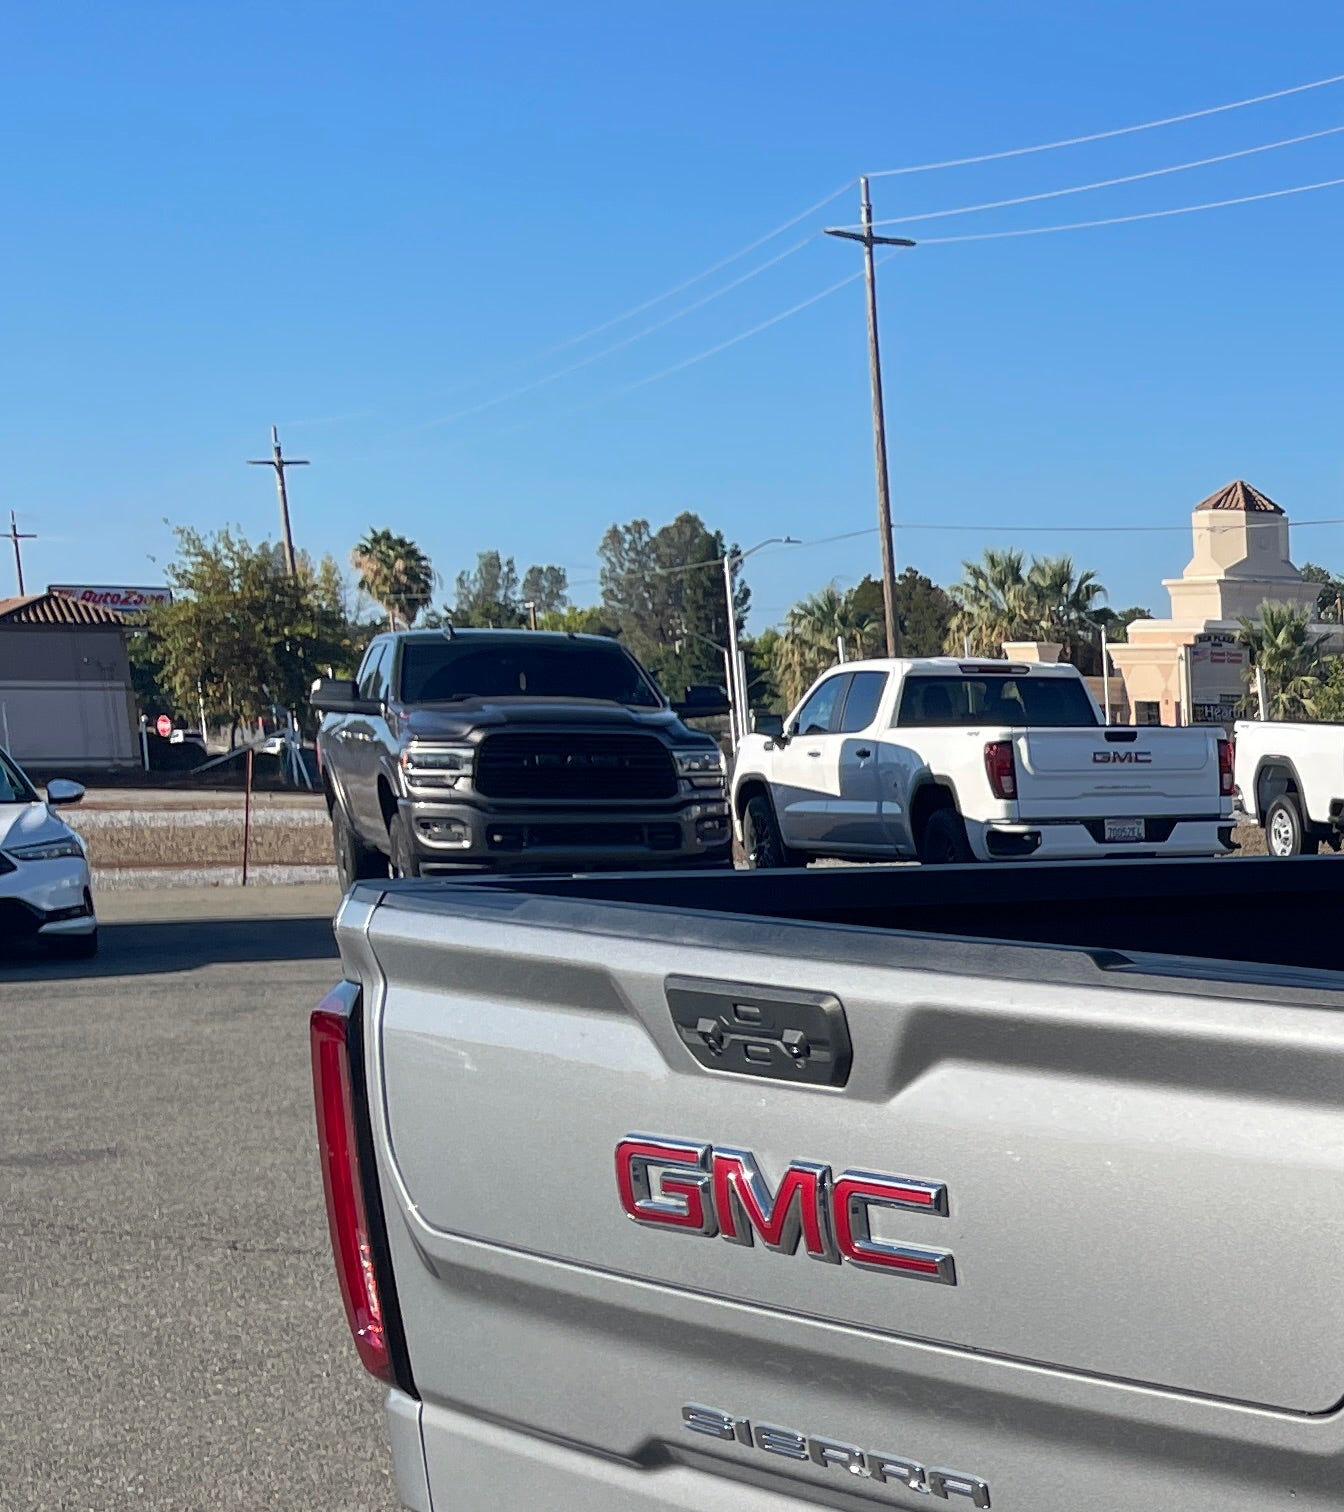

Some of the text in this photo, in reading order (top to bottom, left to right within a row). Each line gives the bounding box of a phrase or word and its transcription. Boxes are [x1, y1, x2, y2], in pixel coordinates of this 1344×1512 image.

[1092, 751, 1152, 763] GMC
[615, 1131, 957, 1287] GMC
[681, 1401, 991, 1510] SIERRA
